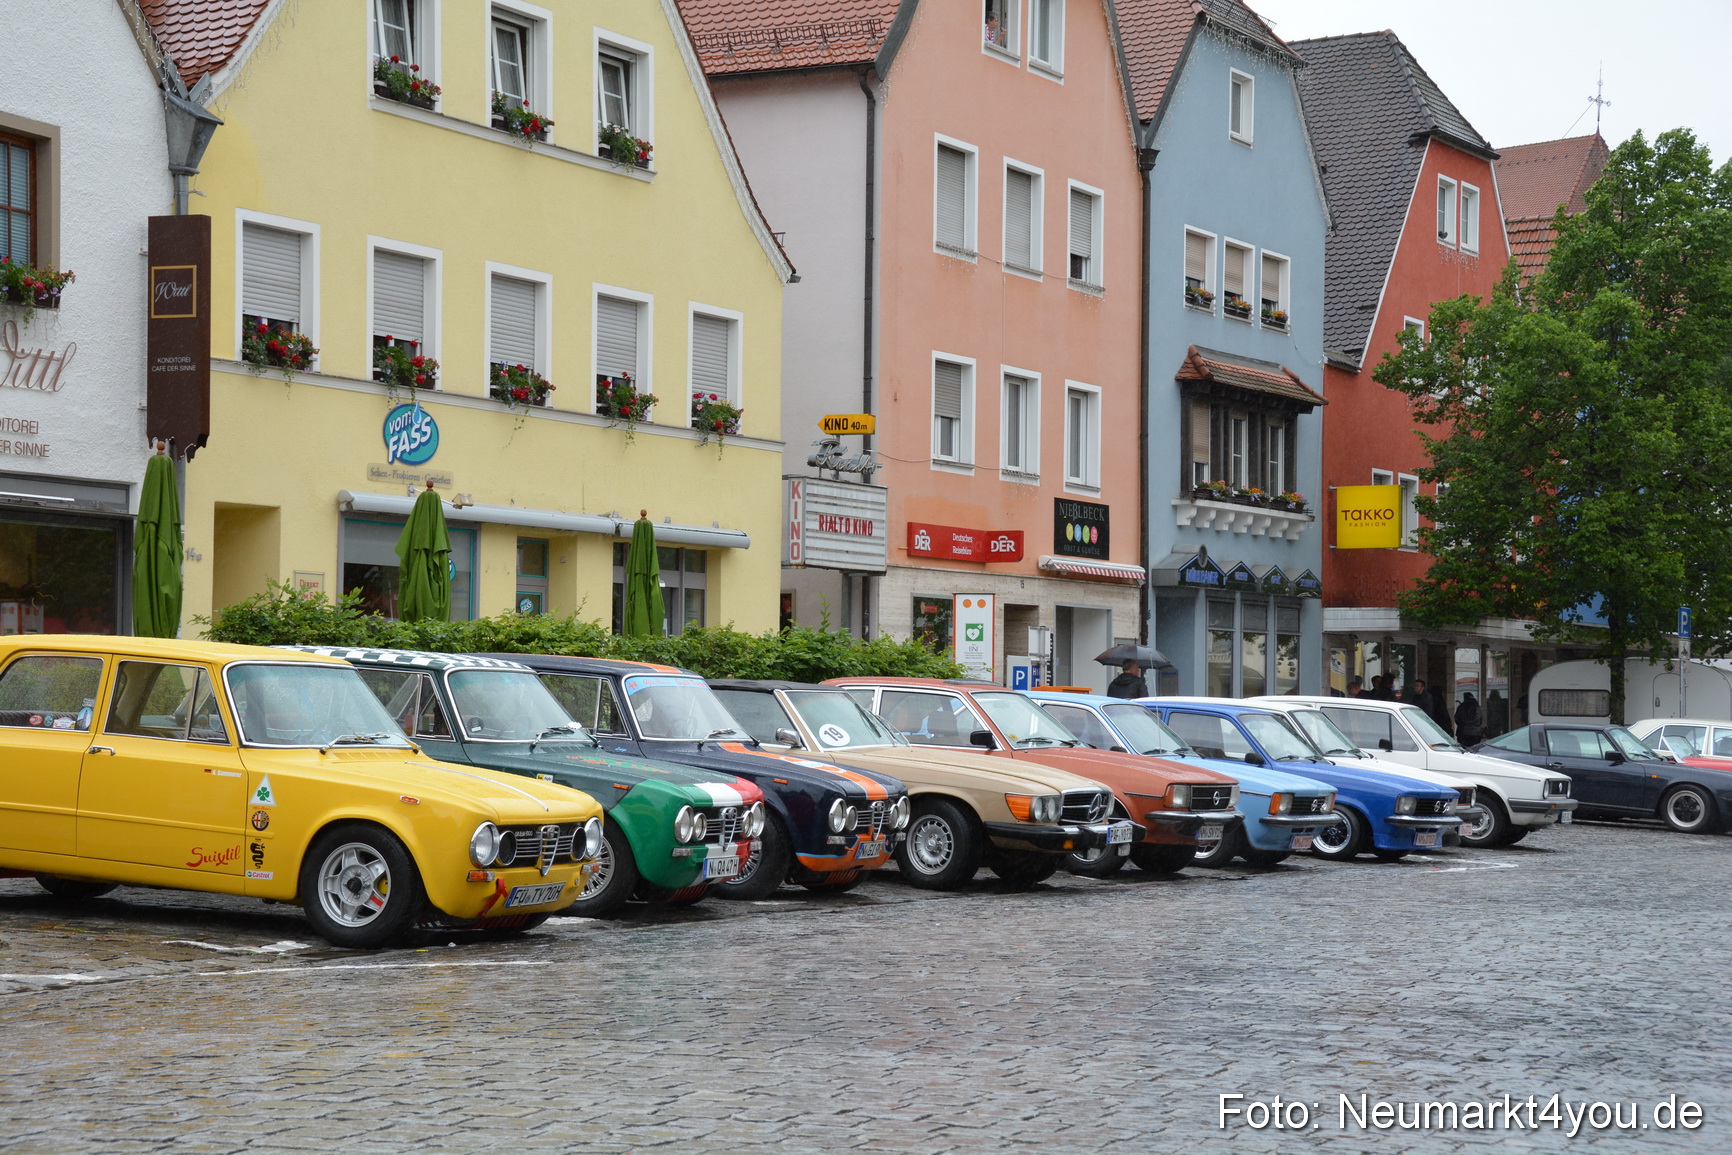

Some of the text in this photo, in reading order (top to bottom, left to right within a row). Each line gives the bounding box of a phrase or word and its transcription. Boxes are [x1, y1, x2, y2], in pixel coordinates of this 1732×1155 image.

[0, 417, 39, 434] ITOREI
[389, 411, 412, 434] vom
[824, 418, 849, 431] KINO
[388, 416, 431, 462] FASS
[15, 441, 50, 458] SINNE
[790, 480, 802, 561] KINO
[853, 520, 874, 537] KINO
[914, 533, 931, 551] DER
[952, 533, 973, 543] Deutsches
[990, 539, 1016, 553] DER
[1681, 611, 1689, 634] P
[1015, 670, 1026, 686] P
[823, 726, 844, 742] 19
[186, 845, 241, 868] Suixtil
[252, 871, 270, 879] Castrol
